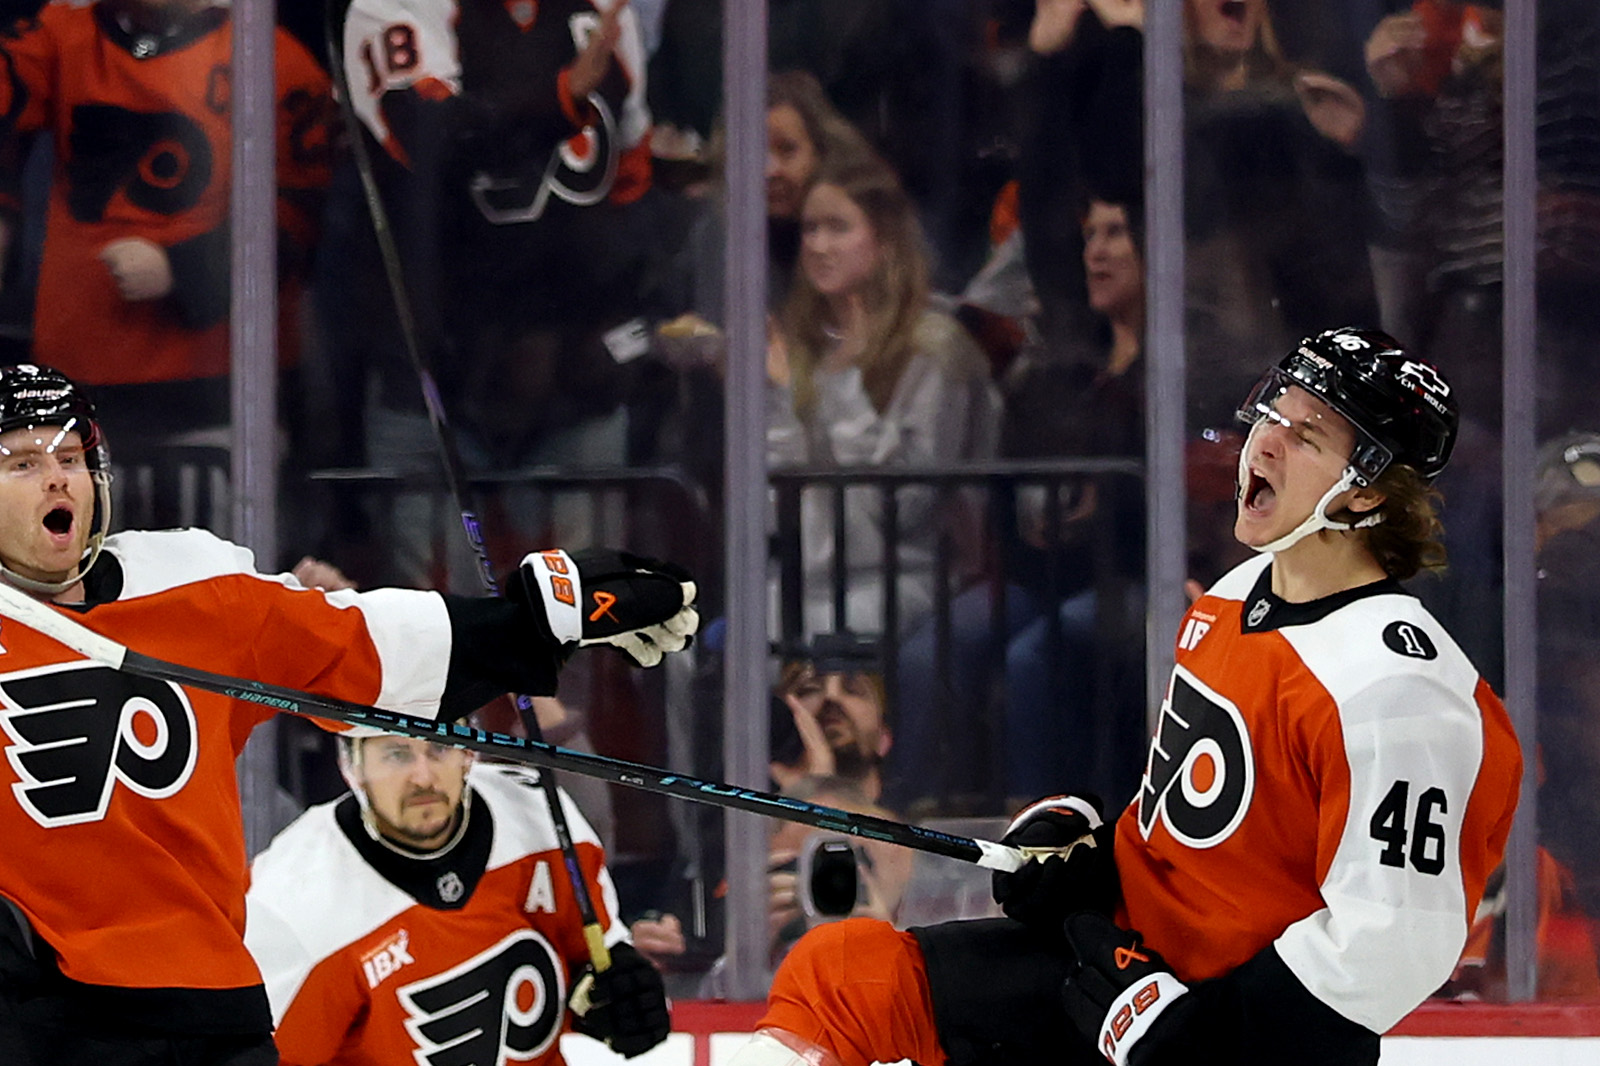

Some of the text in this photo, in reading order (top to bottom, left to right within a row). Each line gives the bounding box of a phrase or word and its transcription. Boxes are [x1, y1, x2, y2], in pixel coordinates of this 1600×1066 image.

[1397, 625, 1427, 657] 1
[1369, 779, 1448, 877] 46
[523, 859, 557, 914] A
[363, 937, 416, 990] IBX
